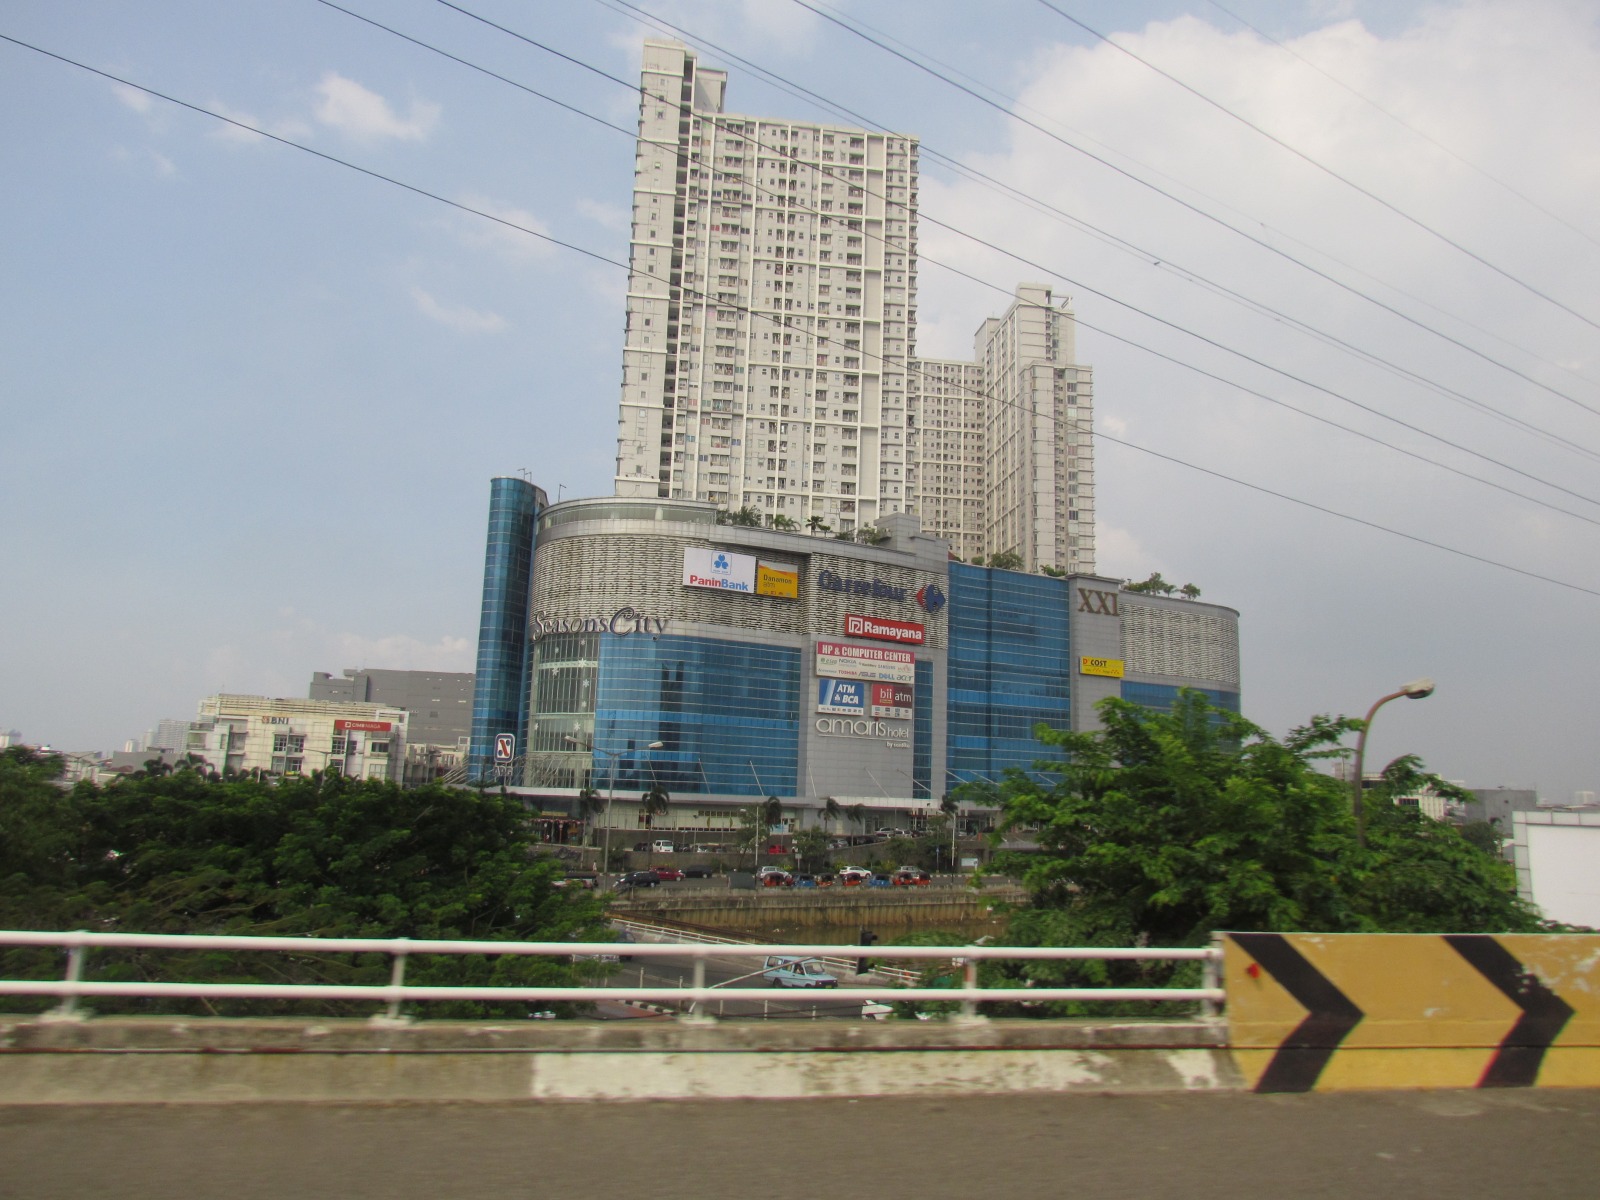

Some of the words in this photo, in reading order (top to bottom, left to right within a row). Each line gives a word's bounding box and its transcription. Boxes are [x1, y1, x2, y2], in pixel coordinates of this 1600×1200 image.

[690, 574, 748, 591] PaninBank
[764, 574, 792, 584] Danamon
[818, 570, 907, 601] Carrefour
[1078, 588, 1120, 616] XXI
[864, 621, 922, 639] Ramayana
[822, 644, 833, 654] HP
[834, 647, 840, 656] &
[842, 646, 882, 660] COMPUTER
[884, 650, 910, 662] CENTER
[837, 684, 856, 694] ATM
[880, 688, 892, 699] bii
[894, 693, 912, 702] atm
[842, 695, 858, 704] BCA
[270, 716, 289, 725] BNI
[816, 718, 886, 736] amaris
[887, 726, 909, 738] hotel
